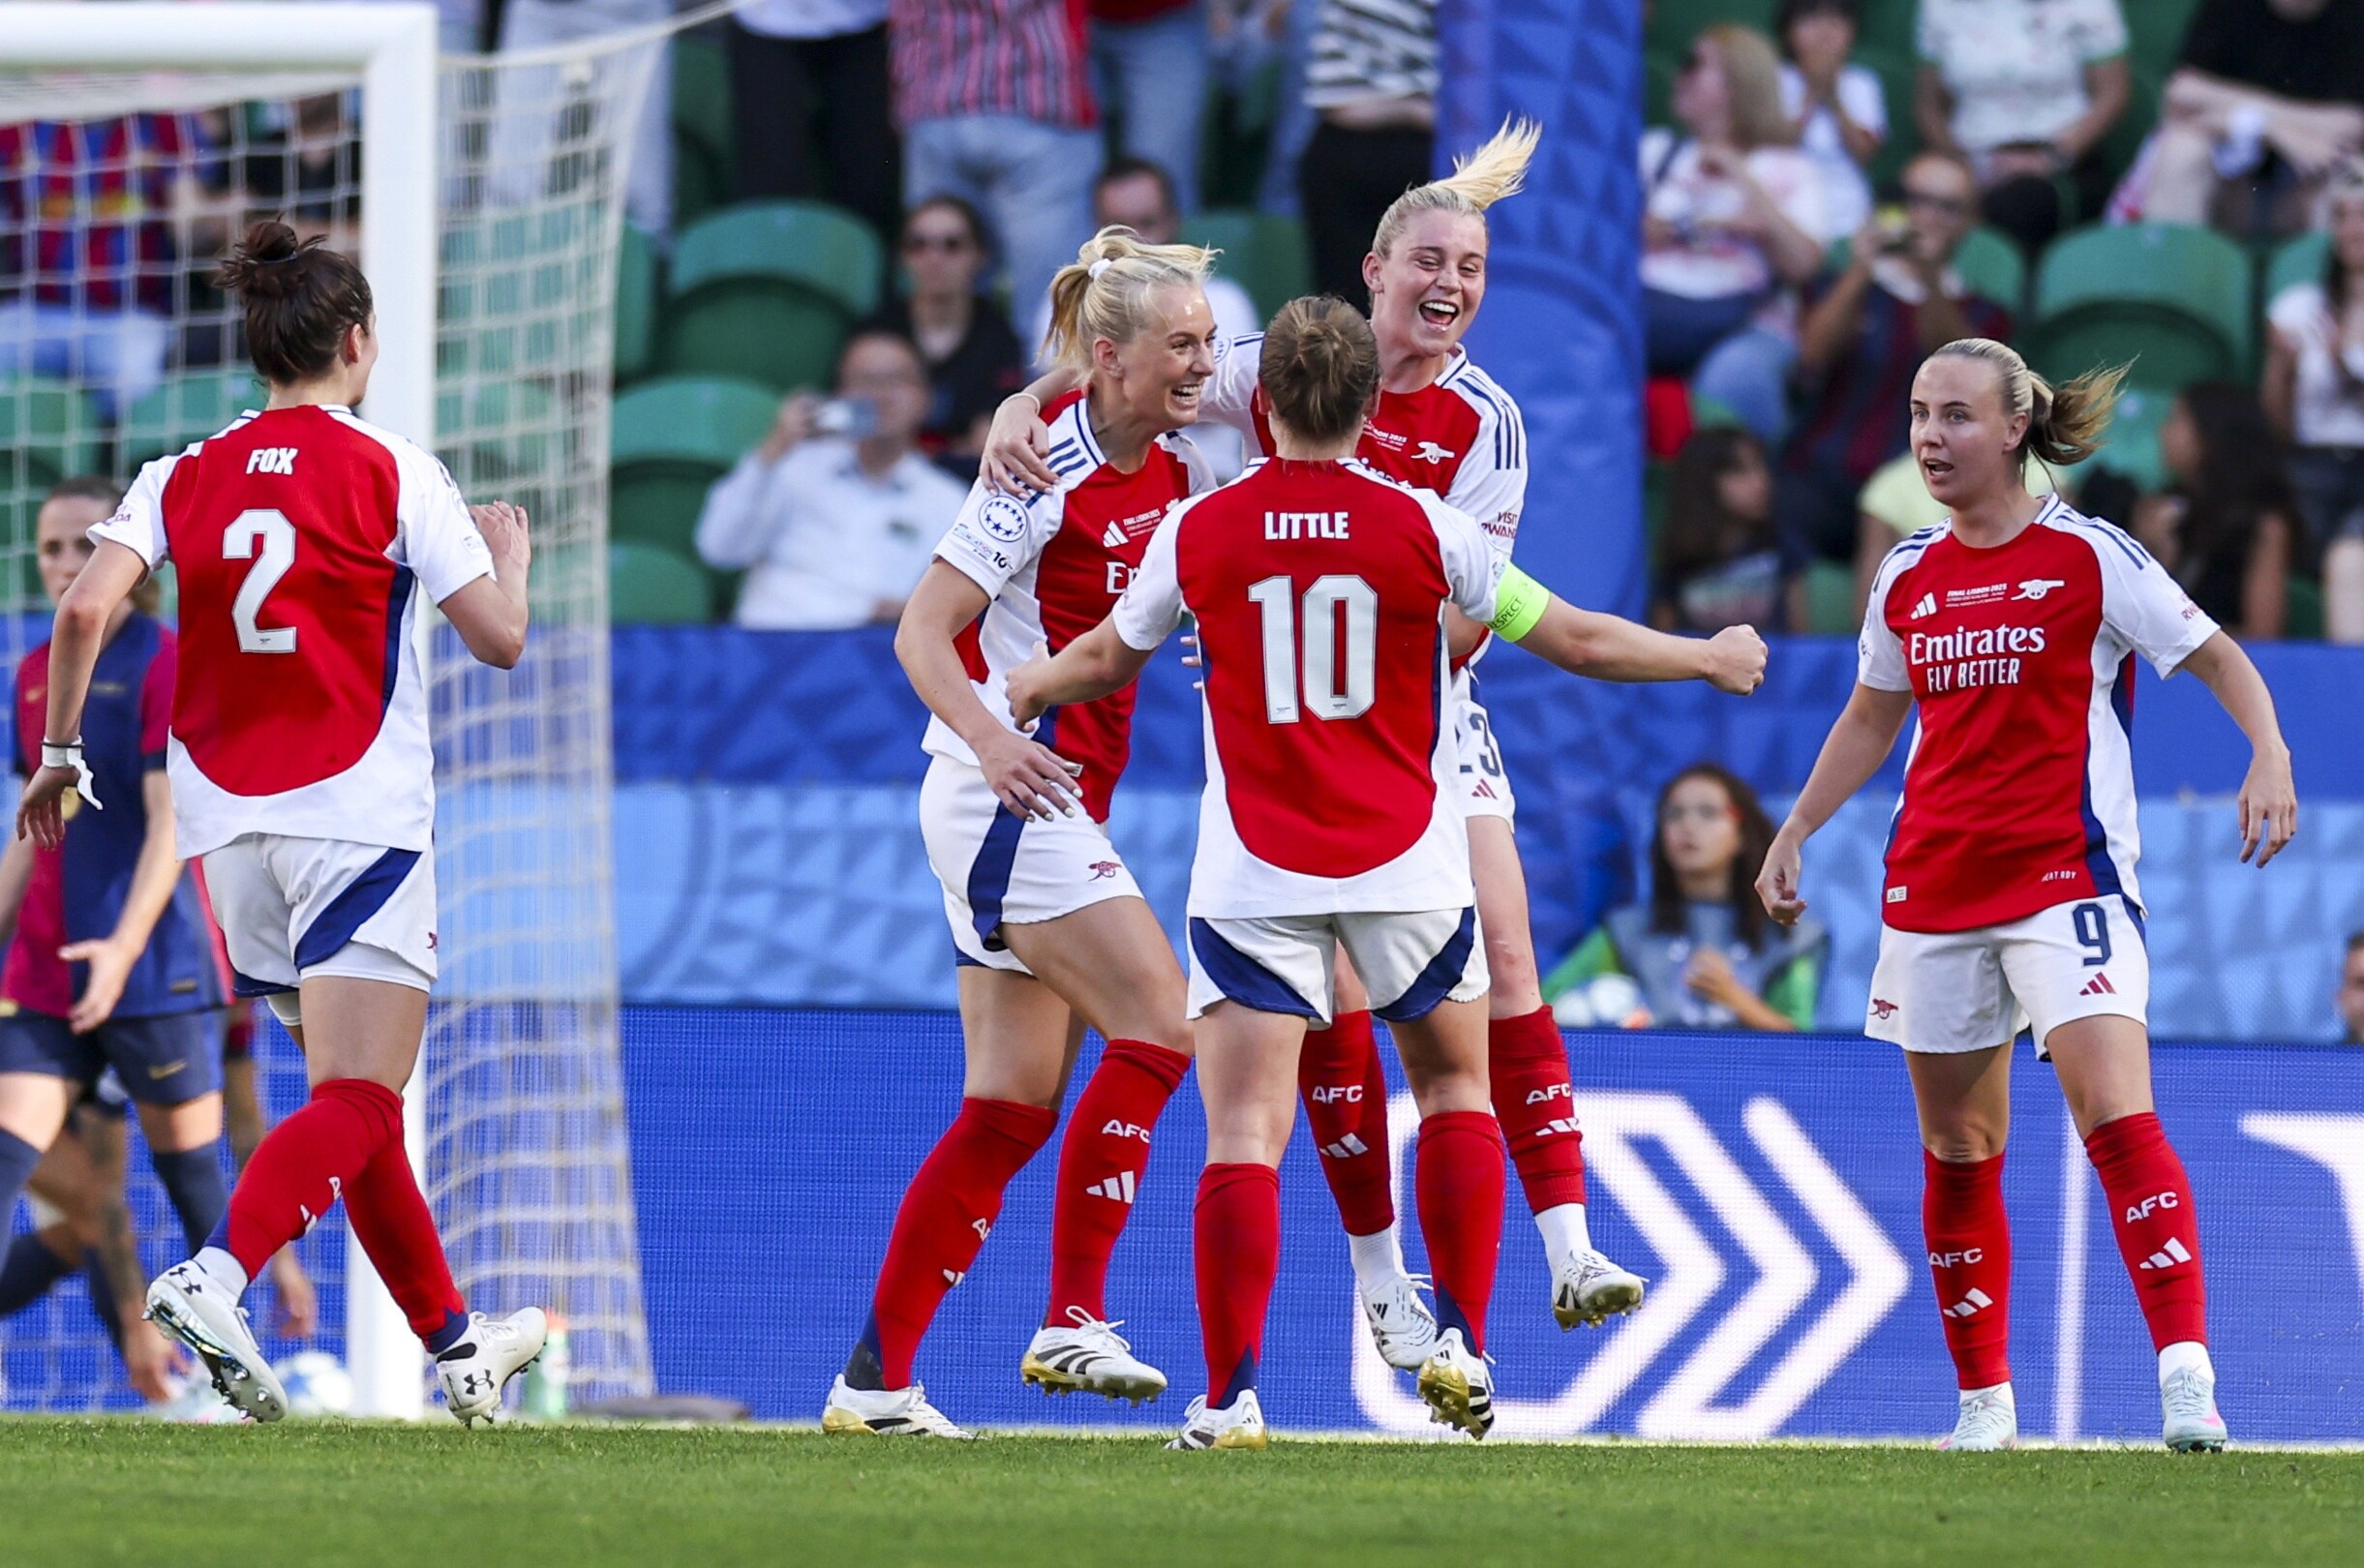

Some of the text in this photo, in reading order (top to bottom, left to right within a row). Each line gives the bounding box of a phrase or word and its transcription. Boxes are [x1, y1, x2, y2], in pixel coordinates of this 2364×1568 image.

[246, 448, 298, 474] FOX
[1265, 511, 1349, 540] LITTLE
[1498, 512, 1518, 524] VISIT
[223, 508, 296, 652] 2
[1966, 587, 1991, 595] LISBON
[1990, 583, 2008, 591] 2025
[1248, 575, 1379, 724] 10
[1911, 623, 2046, 665] Emirates
[1926, 658, 2020, 693] FLY BETTER
[2073, 903, 2111, 966] 9
[1312, 1085, 1363, 1103] AFC
[1526, 1082, 1571, 1104] AFC
[2126, 1191, 2178, 1223] AFC
[1928, 1248, 1983, 1268] AFC
